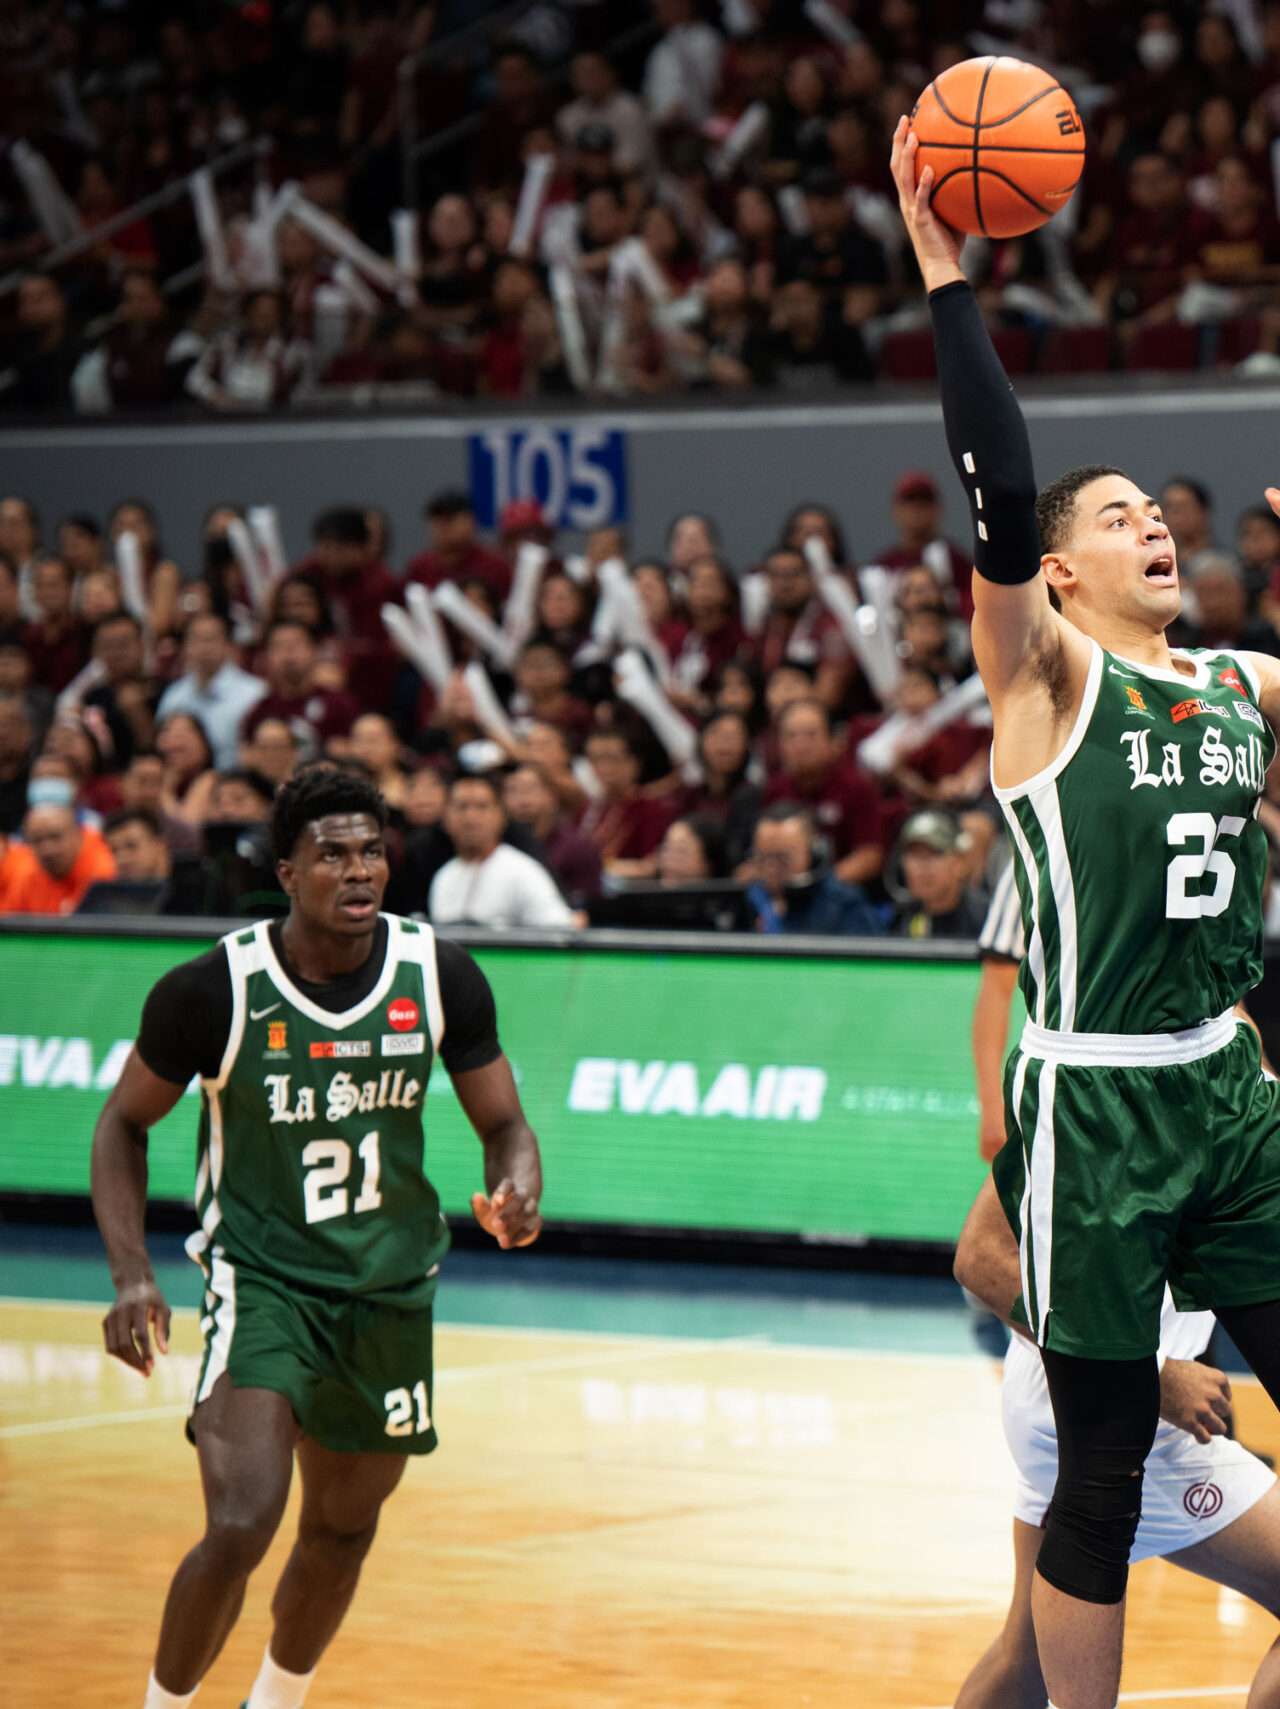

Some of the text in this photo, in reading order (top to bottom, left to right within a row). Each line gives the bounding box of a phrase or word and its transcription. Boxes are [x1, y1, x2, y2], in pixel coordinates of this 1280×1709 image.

[481, 425, 617, 530] 105
[1119, 725, 1266, 793] La Sall
[1165, 812, 1248, 919] 25
[264, 1067, 421, 1125] La Salle
[302, 1131, 383, 1225] 21
[384, 1380, 431, 1437] 21
